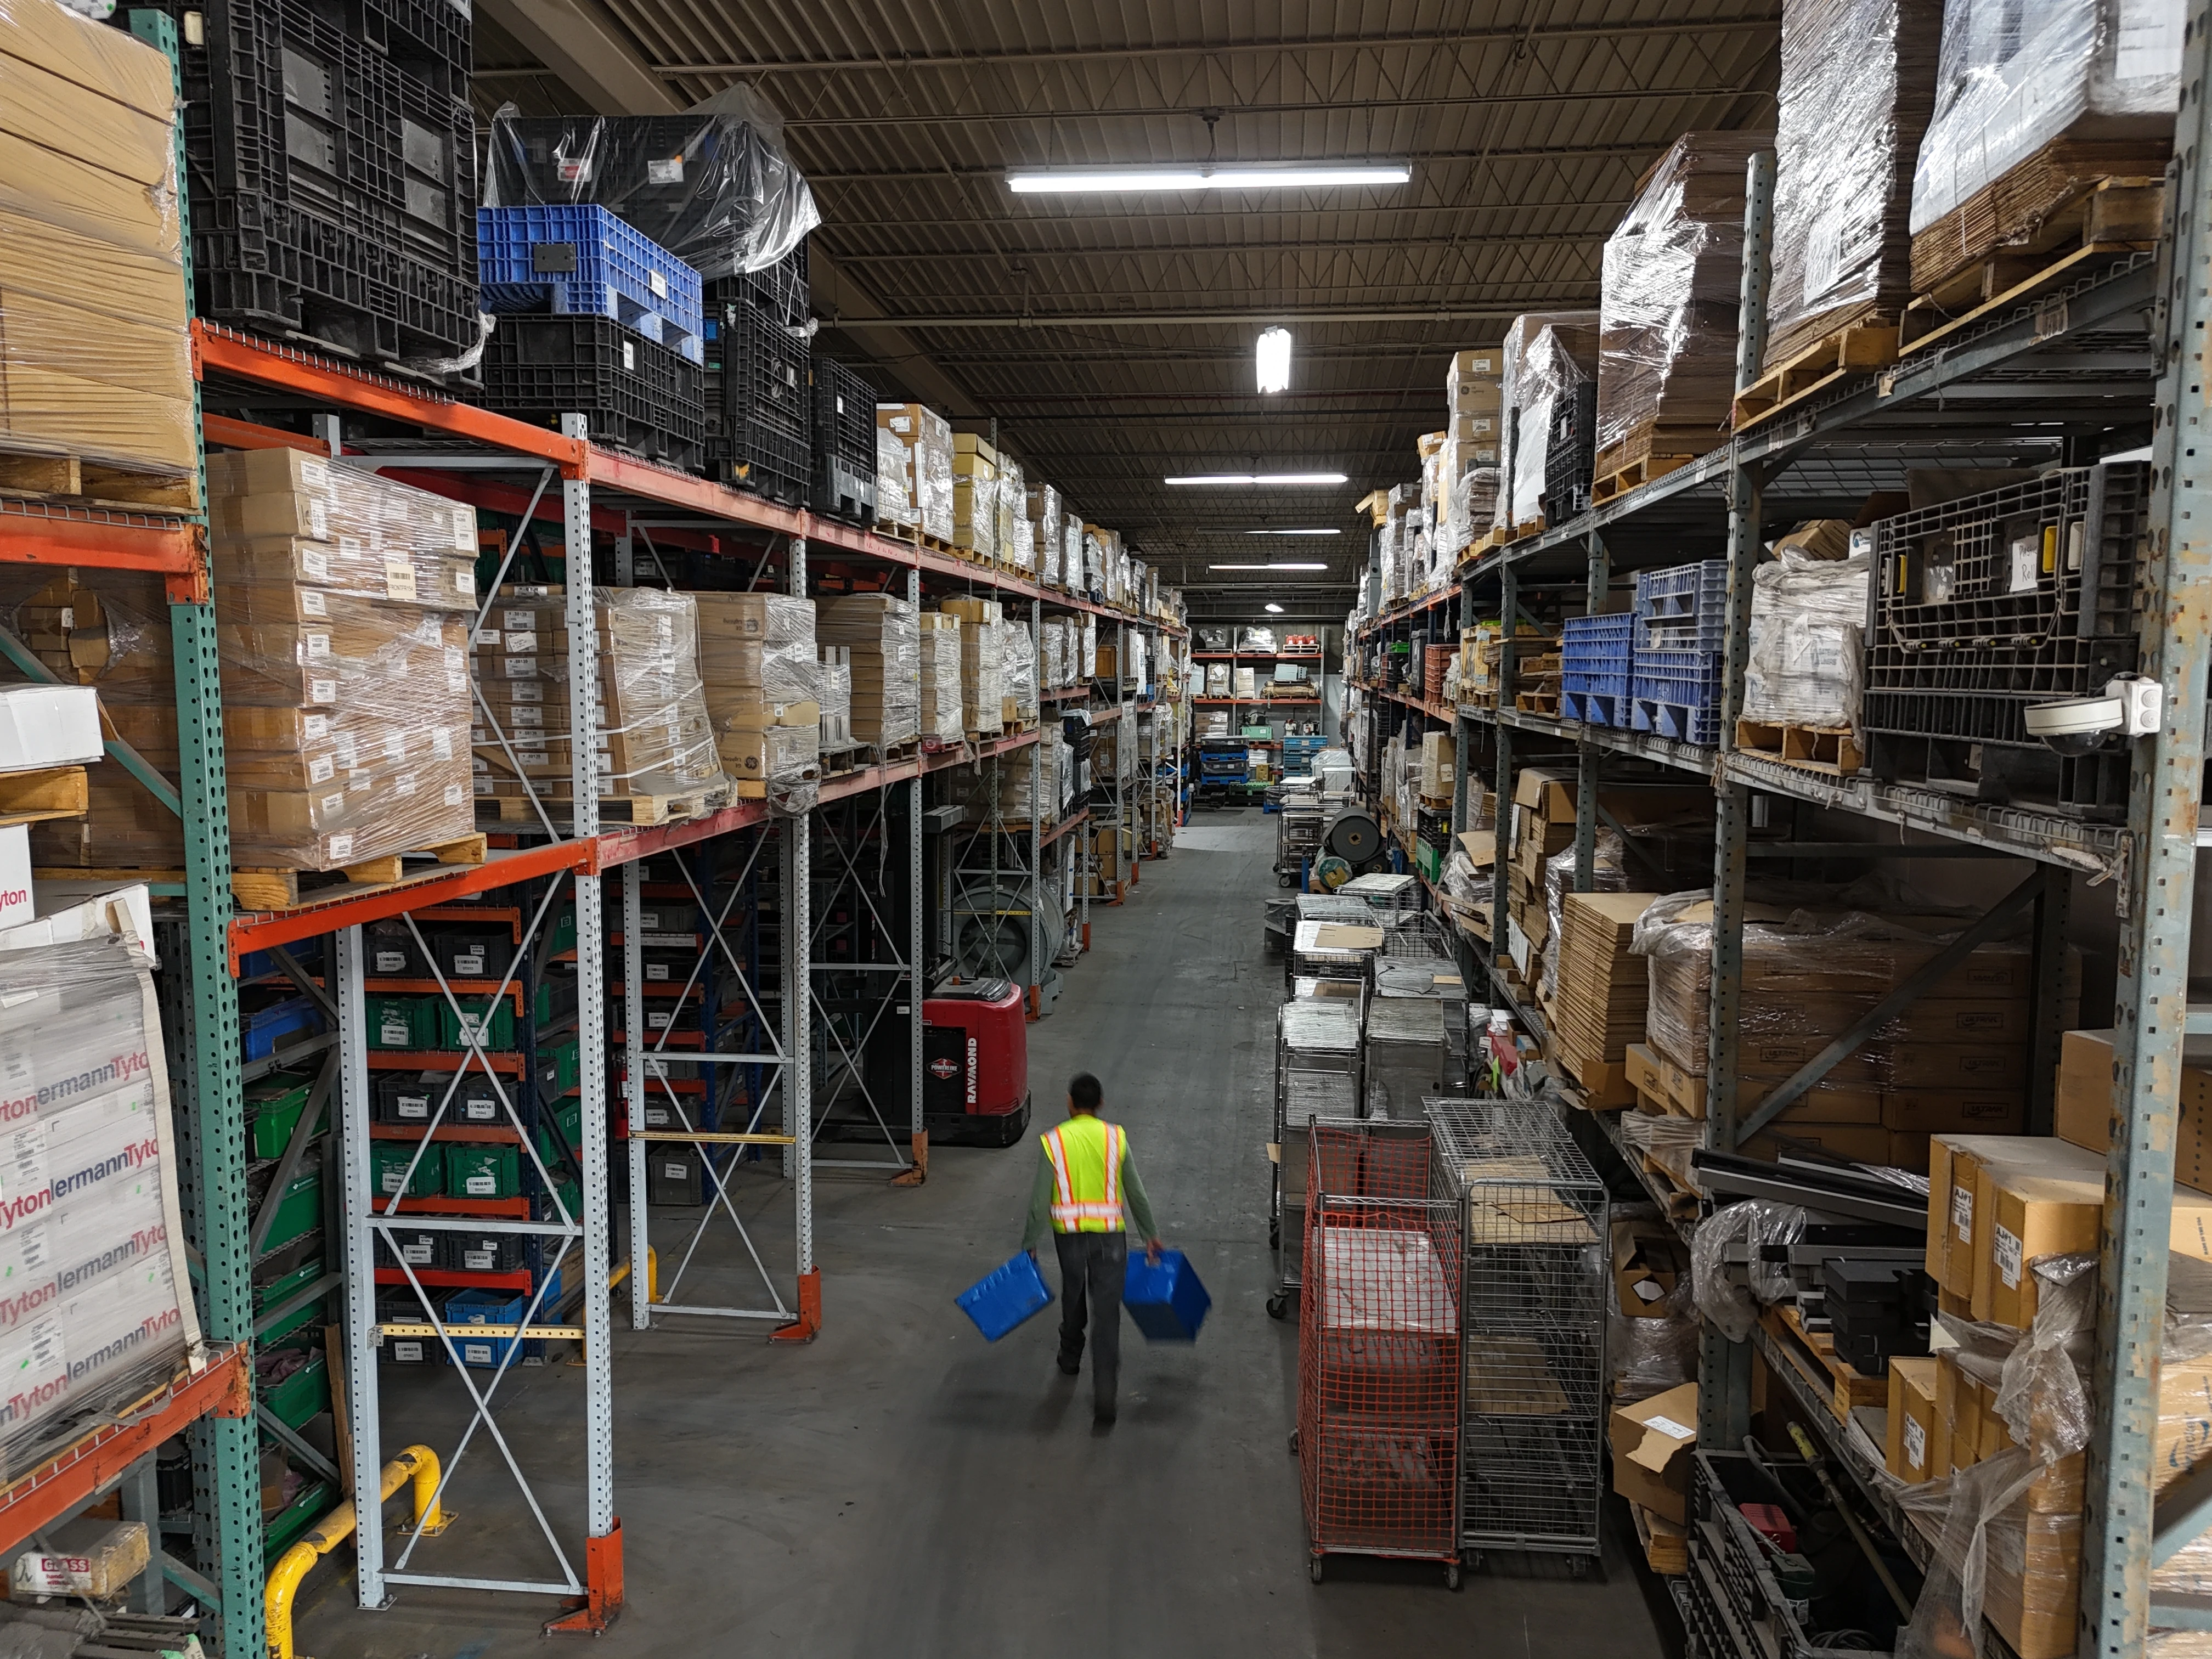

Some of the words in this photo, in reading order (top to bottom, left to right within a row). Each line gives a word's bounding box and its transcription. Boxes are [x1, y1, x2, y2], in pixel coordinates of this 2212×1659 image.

[967, 1037, 977, 1104] RAYMOND
[1955, 1189, 1972, 1204] AJ#1
[1996, 1227, 2012, 1245] AJ#1
